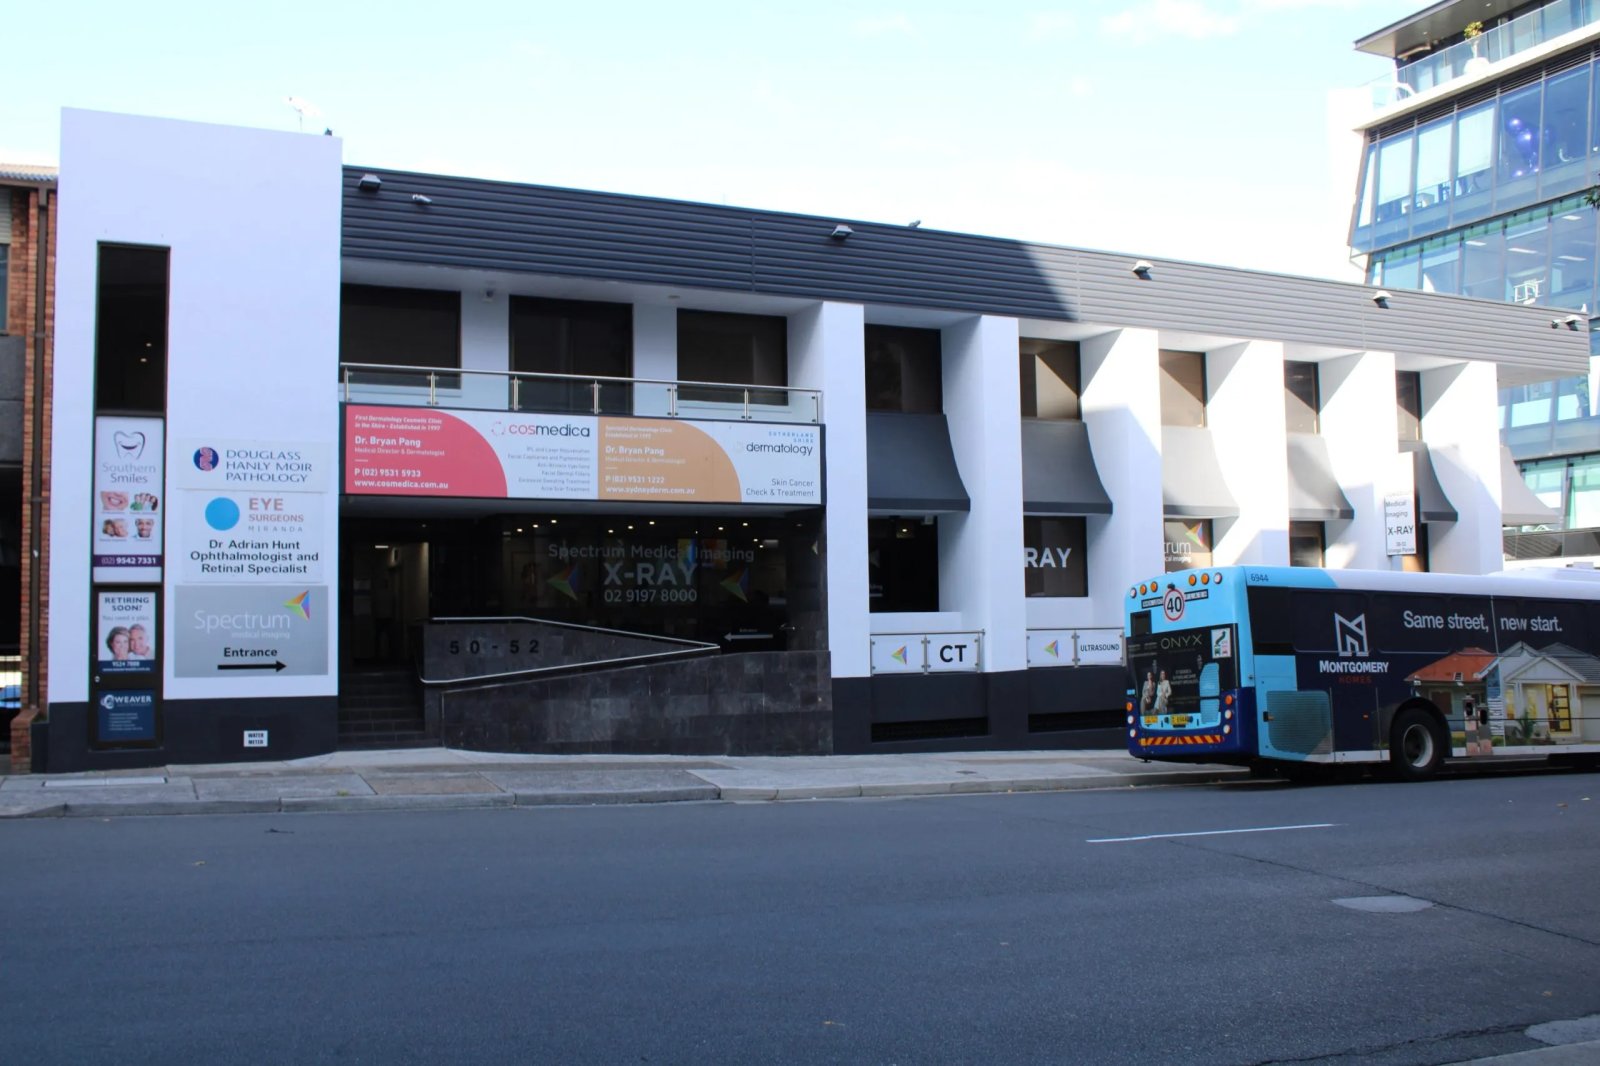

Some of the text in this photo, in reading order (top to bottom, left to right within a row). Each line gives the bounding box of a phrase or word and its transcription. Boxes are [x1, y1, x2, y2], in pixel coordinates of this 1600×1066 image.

[508, 424, 591, 438] cosmedica
[354, 435, 421, 448] Dr. Bryan Pang
[605, 445, 665, 457] Dr. Bryan Pang
[746, 442, 814, 456] dermatology
[226, 449, 302, 461] DOUGLASS
[102, 462, 157, 473] Southern
[226, 461, 313, 472] HANLY MOIR
[110, 472, 149, 484] Smiles
[226, 472, 308, 483] PATHOLOGY
[354, 467, 421, 478] P (02) 9531 5933
[354, 479, 449, 489] www.cosmedica.com.au
[771, 478, 814, 488] Skin Cancer
[605, 486, 696, 496] www.sydneyderm.com.au
[745, 488, 815, 497] Check & Treatment
[248, 498, 284, 511] EYE
[248, 513, 305, 523] SURGEONS
[1387, 525, 1414, 536] X-RAY
[208, 539, 301, 550] Dr Adrian Hunt
[190, 550, 319, 563] Ophthalmologist and
[548, 543, 626, 563] Spectrum
[694, 545, 755, 563] Imaging
[101, 556, 156, 566] (02) 9542 7331
[201, 563, 308, 576] Retinal Specialist
[603, 562, 698, 586] X-RAY
[1250, 573, 1269, 582] 6944
[104, 596, 150, 604] RETIRING
[603, 589, 698, 602] 02 9197 8000
[111, 604, 143, 612] SOON?
[1166, 596, 1182, 613] 40
[193, 609, 291, 634] Spectrum
[1403, 610, 1562, 632] Same street, new start.
[231, 630, 291, 640] medical imaging
[1160, 634, 1202, 649] ONYX
[223, 647, 278, 657] Entrance
[1080, 643, 1119, 652] ULTRASOUND
[939, 645, 967, 663] CT
[1319, 660, 1389, 673] MONTGOMERY
[114, 695, 152, 703] WEAVER
